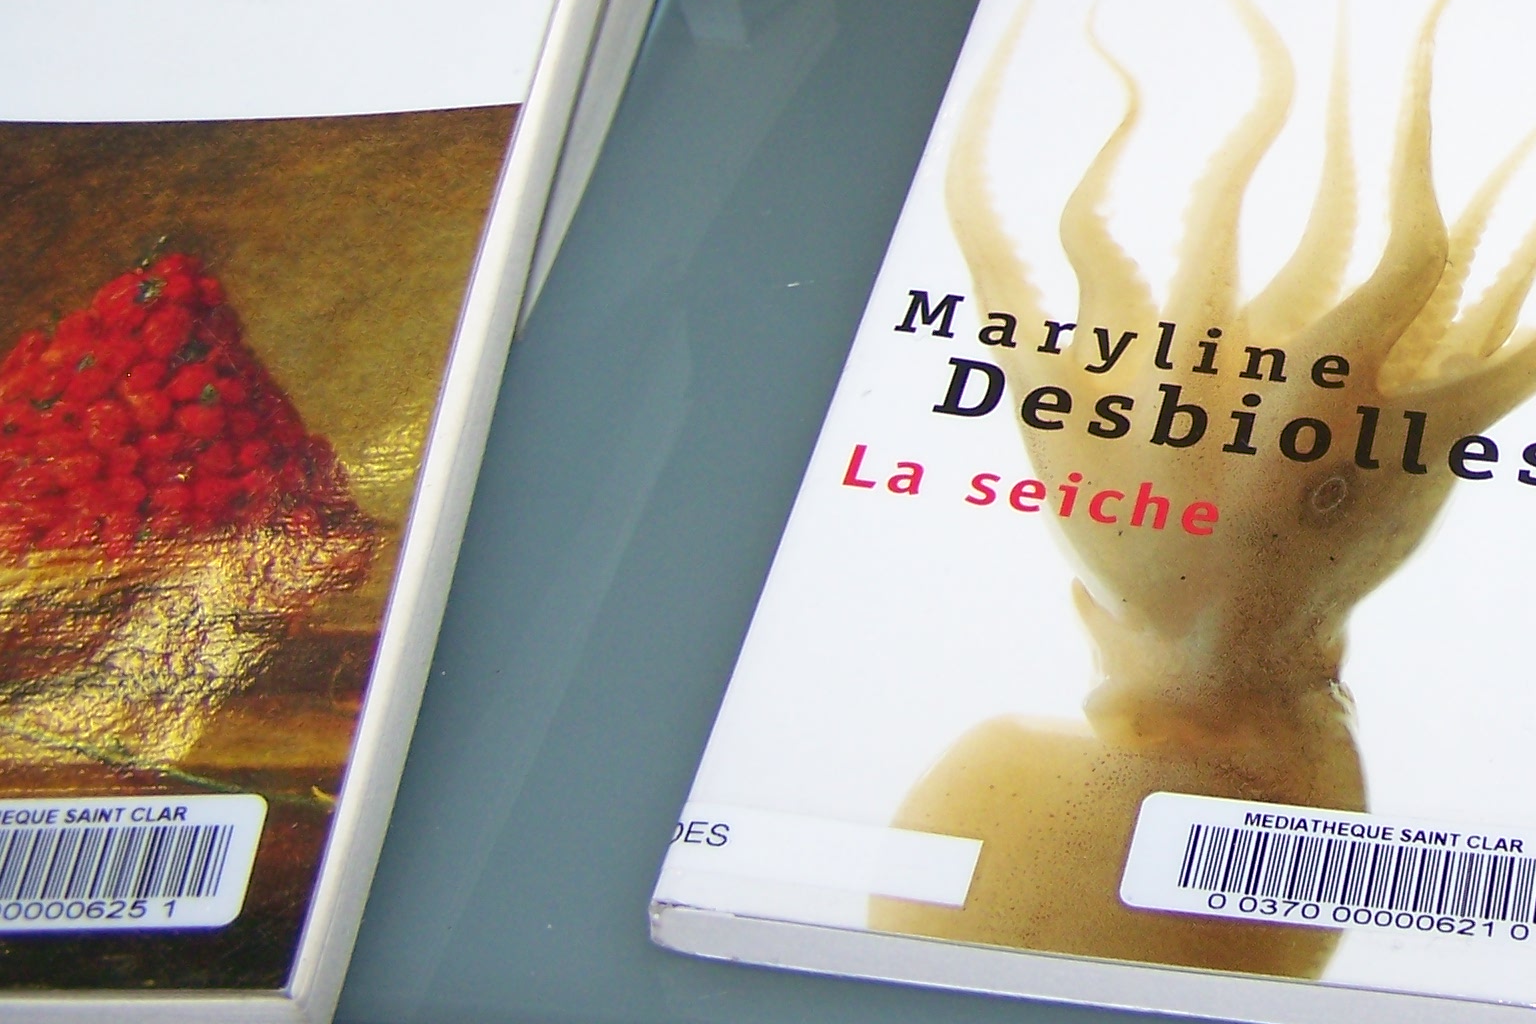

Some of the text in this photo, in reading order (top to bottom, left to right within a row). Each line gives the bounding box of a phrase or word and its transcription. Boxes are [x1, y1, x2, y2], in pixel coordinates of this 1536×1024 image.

[894, 289, 1352, 389] Maryline
[842, 443, 1221, 536] La seiche
[64, 807, 125, 823] SAINT
[131, 806, 188, 822] CLAR
[1244, 812, 1524, 854] MEDIATHEQUE SAINT CLAR
[163, 900, 177, 918] 1
[1207, 893, 1530, 941] 0 0370 00000621 0
